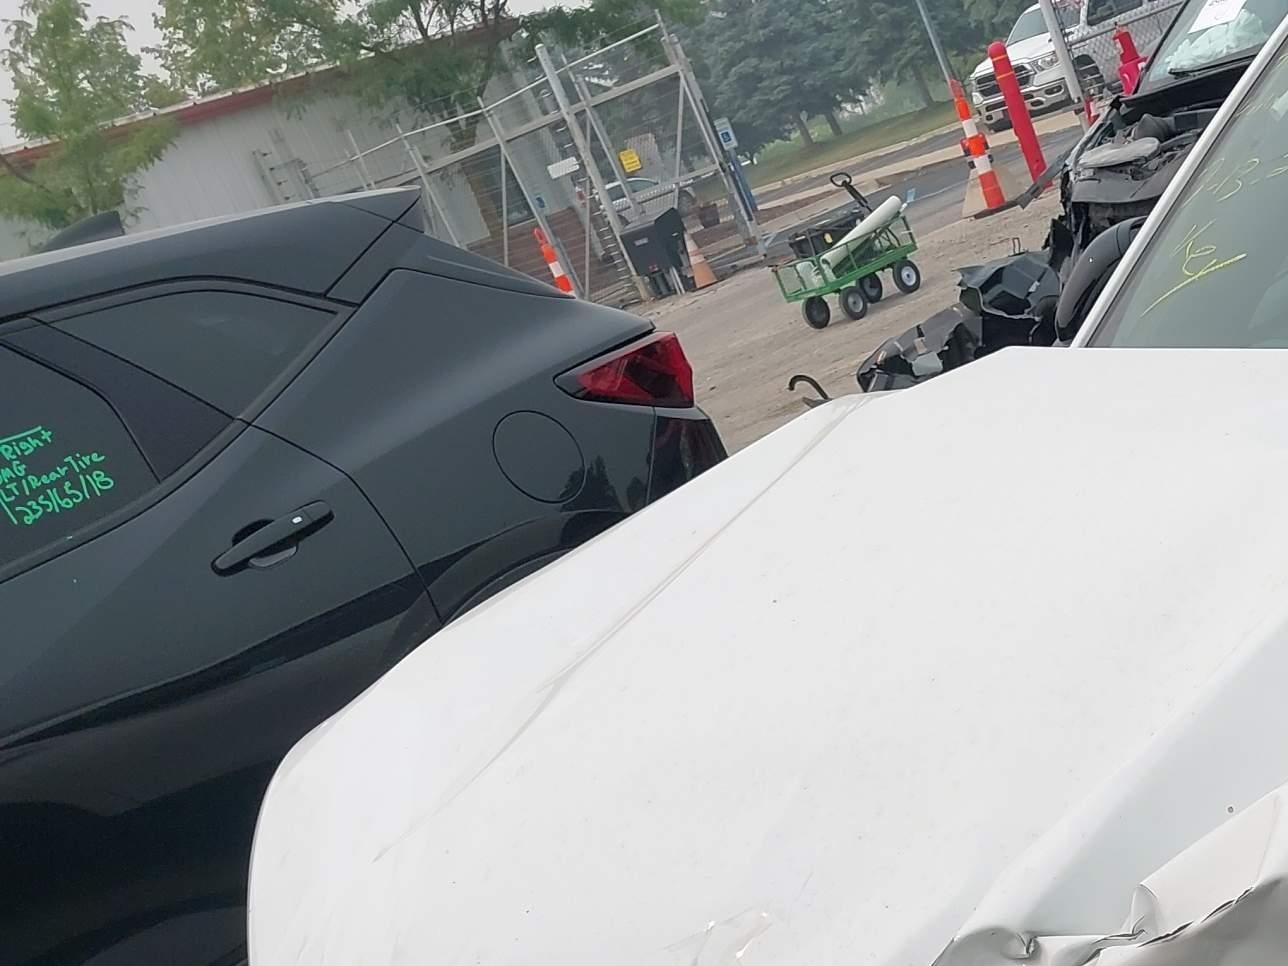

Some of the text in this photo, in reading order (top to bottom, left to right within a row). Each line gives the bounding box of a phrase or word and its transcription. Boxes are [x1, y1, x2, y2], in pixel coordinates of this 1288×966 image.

[0, 430, 52, 460] Right
[0, 460, 26, 485] MG
[64, 451, 106, 472] Tire
[15, 470, 115, 525] 235/65/18
